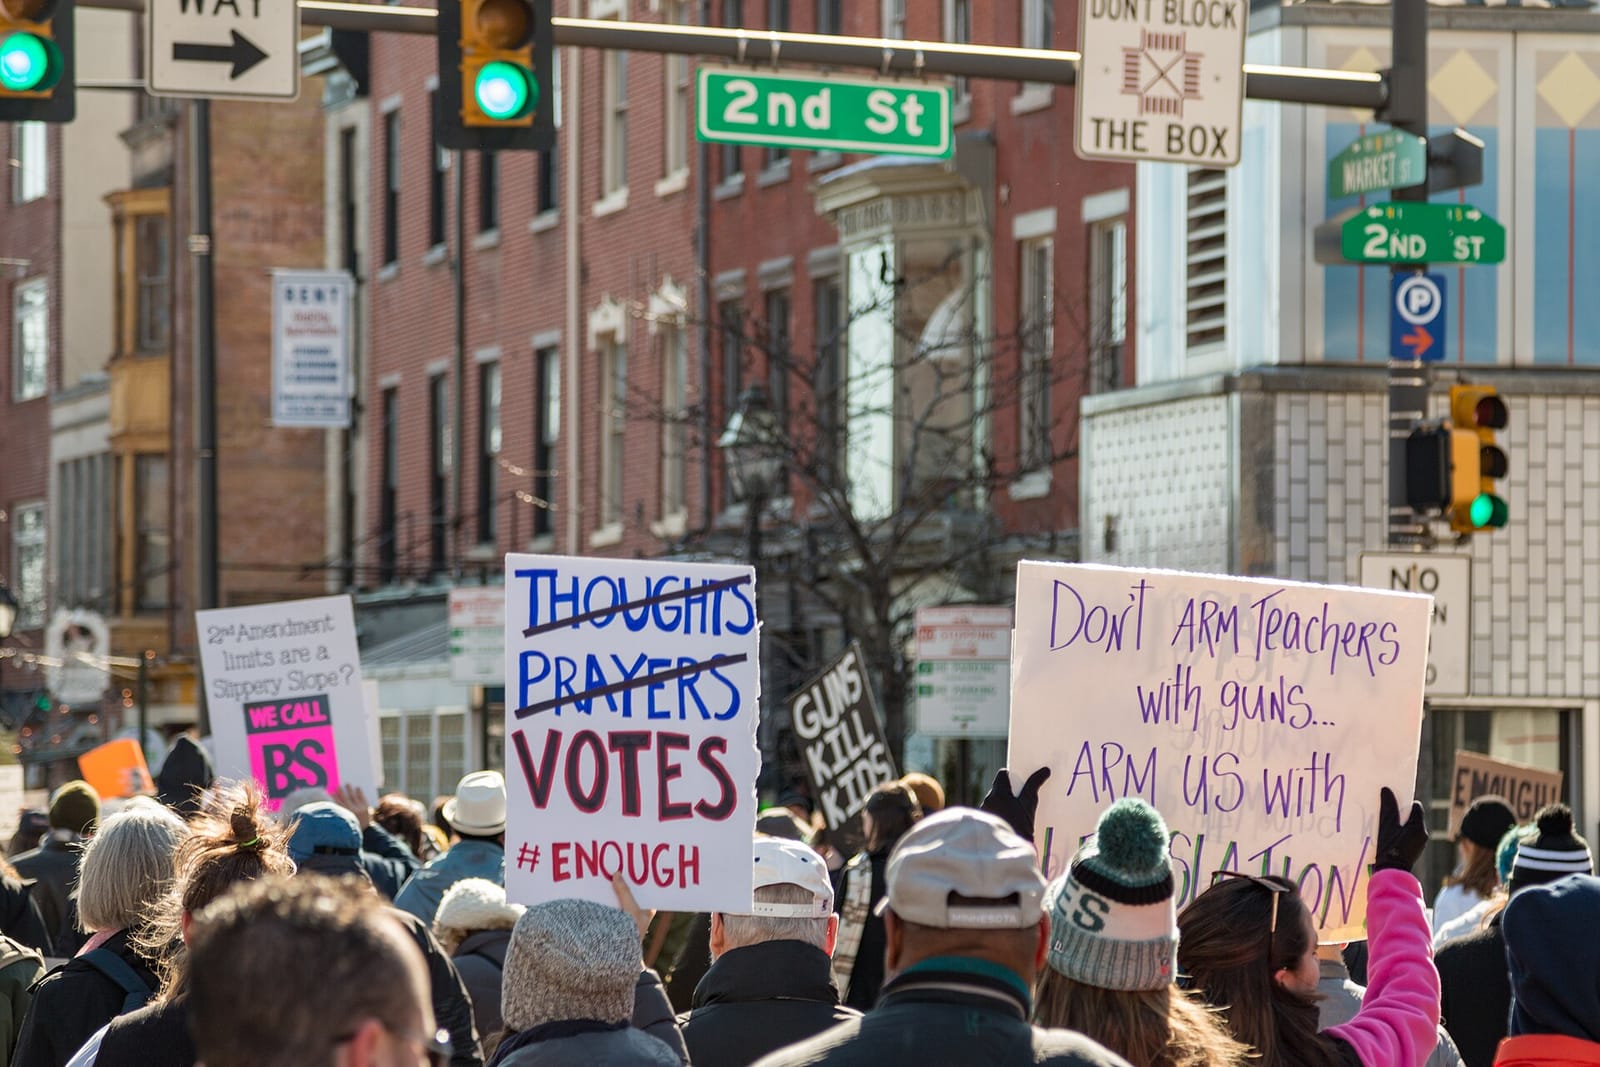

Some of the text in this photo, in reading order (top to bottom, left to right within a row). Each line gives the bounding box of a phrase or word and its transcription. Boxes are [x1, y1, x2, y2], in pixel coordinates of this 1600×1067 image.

[1164, 0, 1236, 29] BLOCK
[723, 79, 925, 137] 2nd St
[1091, 118, 1228, 158] THE BOX
[1343, 152, 1396, 194] MARKET
[1363, 223, 1486, 260] 2ND ST
[1408, 287, 1432, 313] P
[514, 568, 756, 636] THOUGHTS
[1391, 567, 1439, 592] NO
[207, 614, 336, 645] 2nd Amendment
[1171, 597, 1239, 658] ARM
[223, 646, 330, 671] limits are a
[213, 676, 282, 702] Slippery
[517, 650, 742, 721] PRAYERS
[792, 652, 863, 739] GUNS
[1137, 664, 1202, 731] with
[248, 700, 328, 728] WE CALL
[262, 739, 328, 799] BS
[805, 709, 875, 787] KILL
[511, 729, 738, 822] VOTES
[821, 742, 893, 831] KIDS
[1066, 741, 1347, 833] ARM US with
[552, 840, 700, 889] ENOUGH
[951, 911, 1017, 924] MINNESOTA
